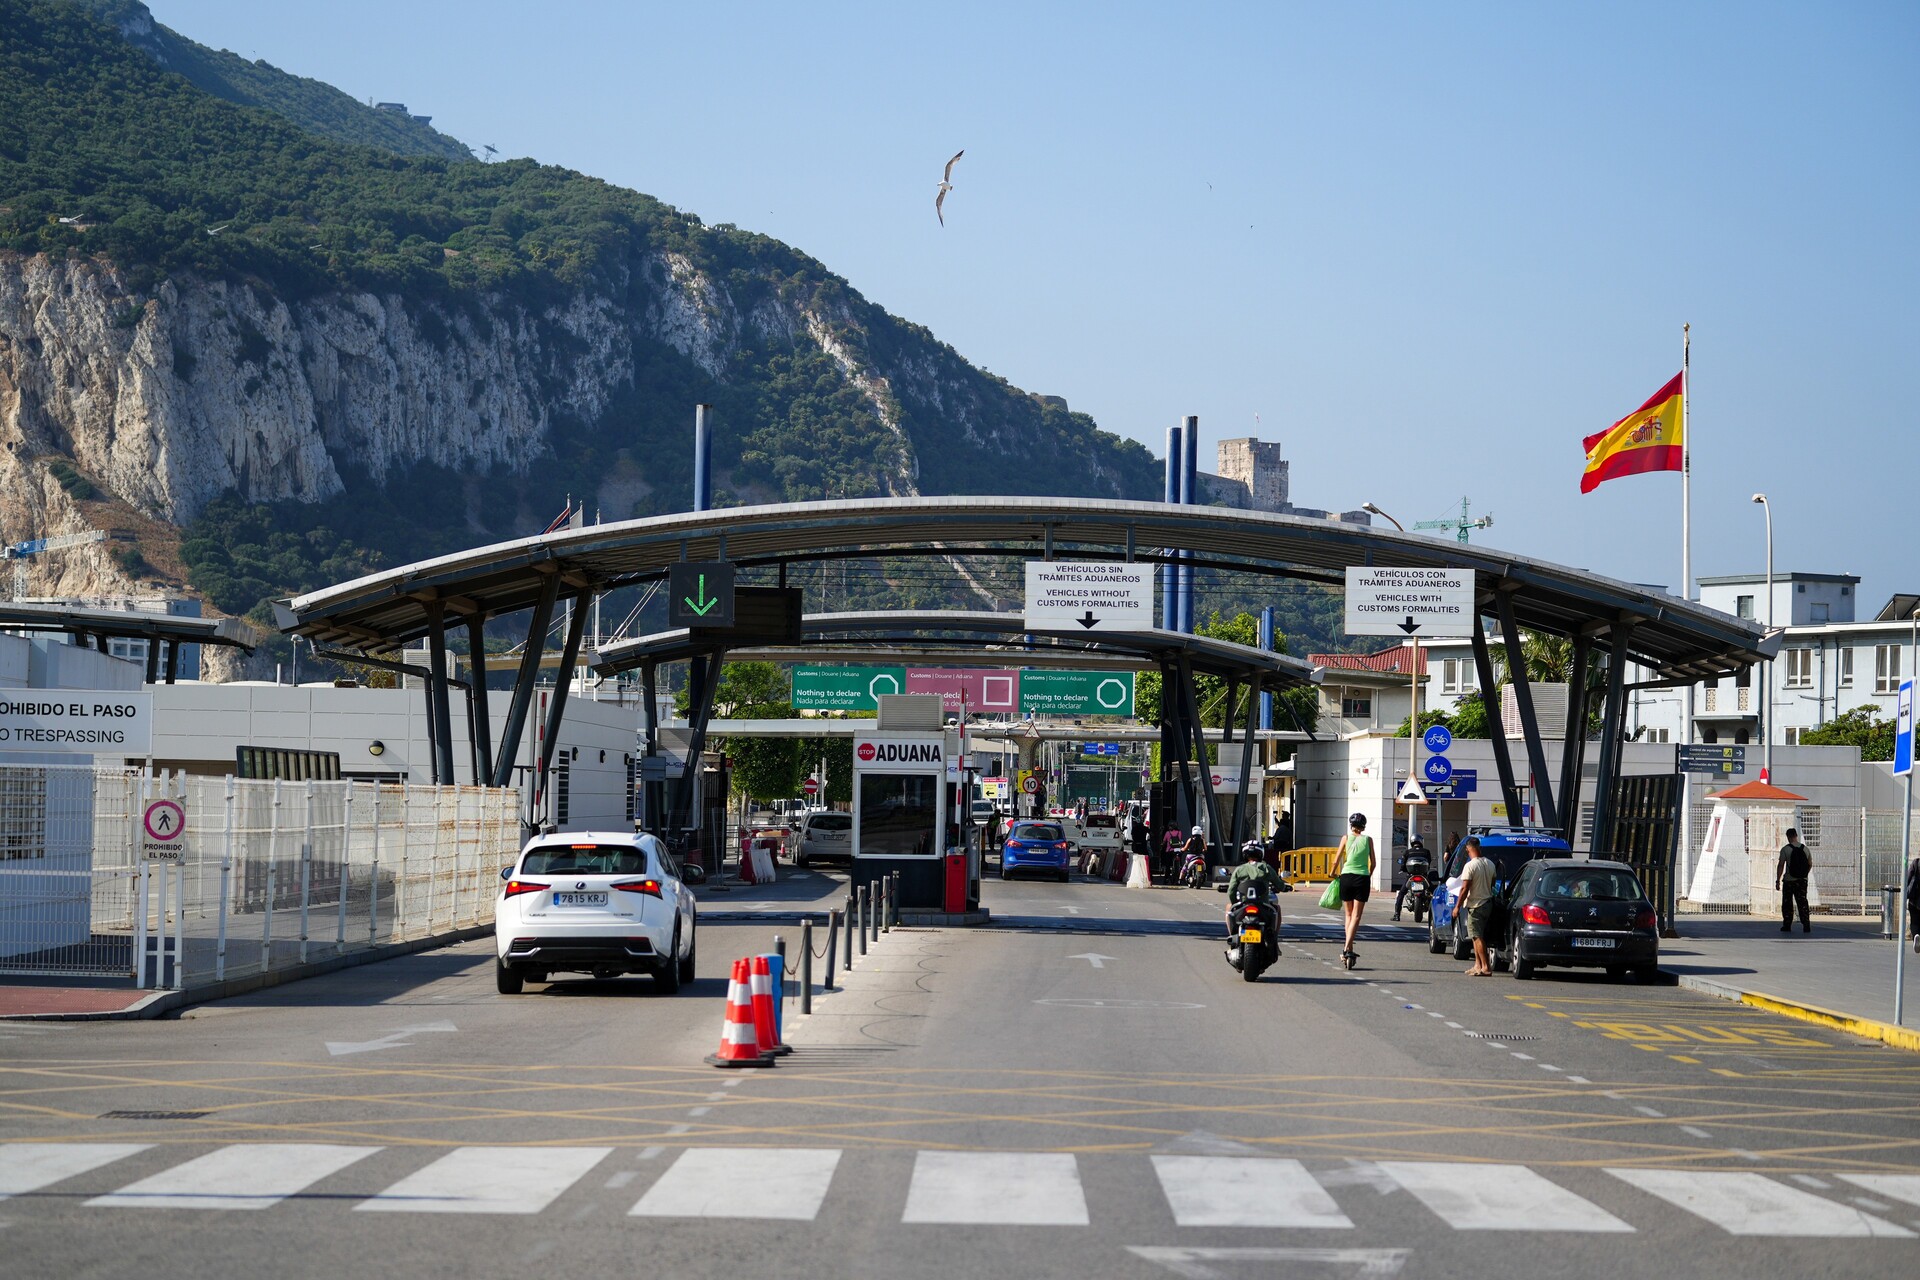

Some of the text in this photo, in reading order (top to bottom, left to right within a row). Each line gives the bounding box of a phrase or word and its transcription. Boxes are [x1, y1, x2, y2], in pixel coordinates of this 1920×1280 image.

[1056, 565, 1106, 573] VEHÍCULOS
[1374, 570, 1424, 578] VEHÍCULOS
[1359, 578, 1402, 586] TRÁMITES
[796, 689, 824, 697] Nothing
[69, 704, 88, 716] EL
[94, 705, 136, 717] PASO
[14, 729, 124, 743] TRESPASSING
[876, 744, 941, 762] ADUANA
[1026, 781, 1036, 789] 10
[562, 895, 605, 903] 7815 KRJ
[1596, 1022, 1834, 1047] BUS
